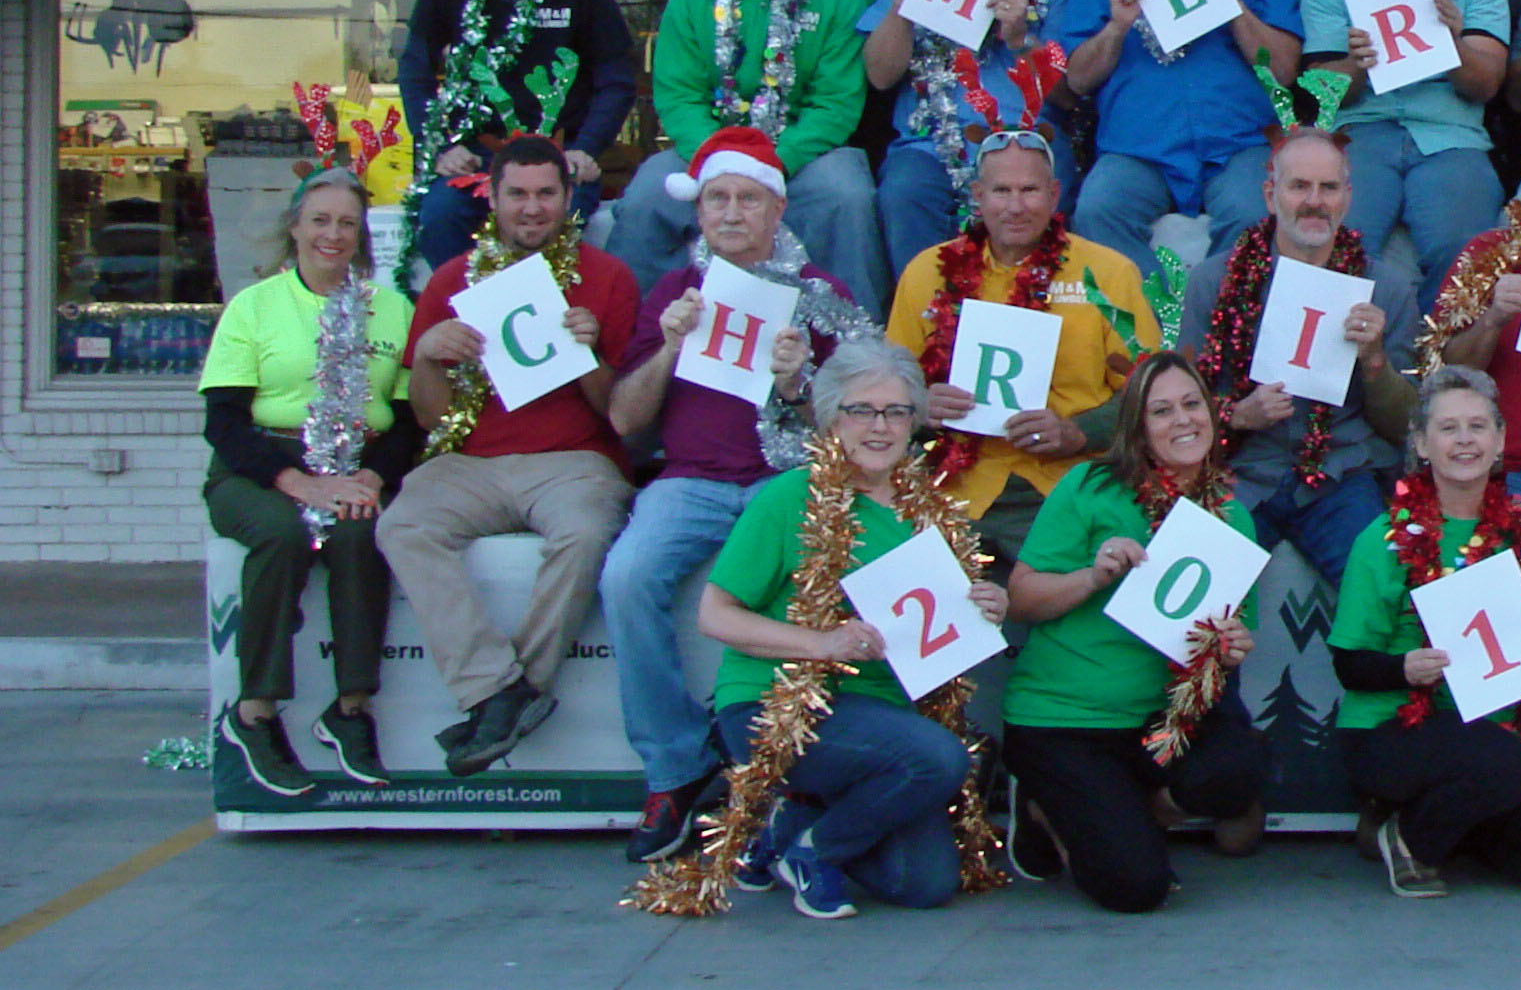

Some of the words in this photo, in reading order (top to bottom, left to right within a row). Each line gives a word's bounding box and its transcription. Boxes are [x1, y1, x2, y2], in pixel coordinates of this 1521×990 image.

[1371, 4, 1433, 64] R
[501, 303, 557, 368] C
[701, 301, 766, 372] H
[974, 343, 1025, 410] R
[1288, 307, 1326, 370] I
[318, 640, 424, 659] Wern
[892, 587, 960, 658] 2
[1462, 609, 1521, 681] 1
[327, 785, 562, 803] www.westernforest.com
